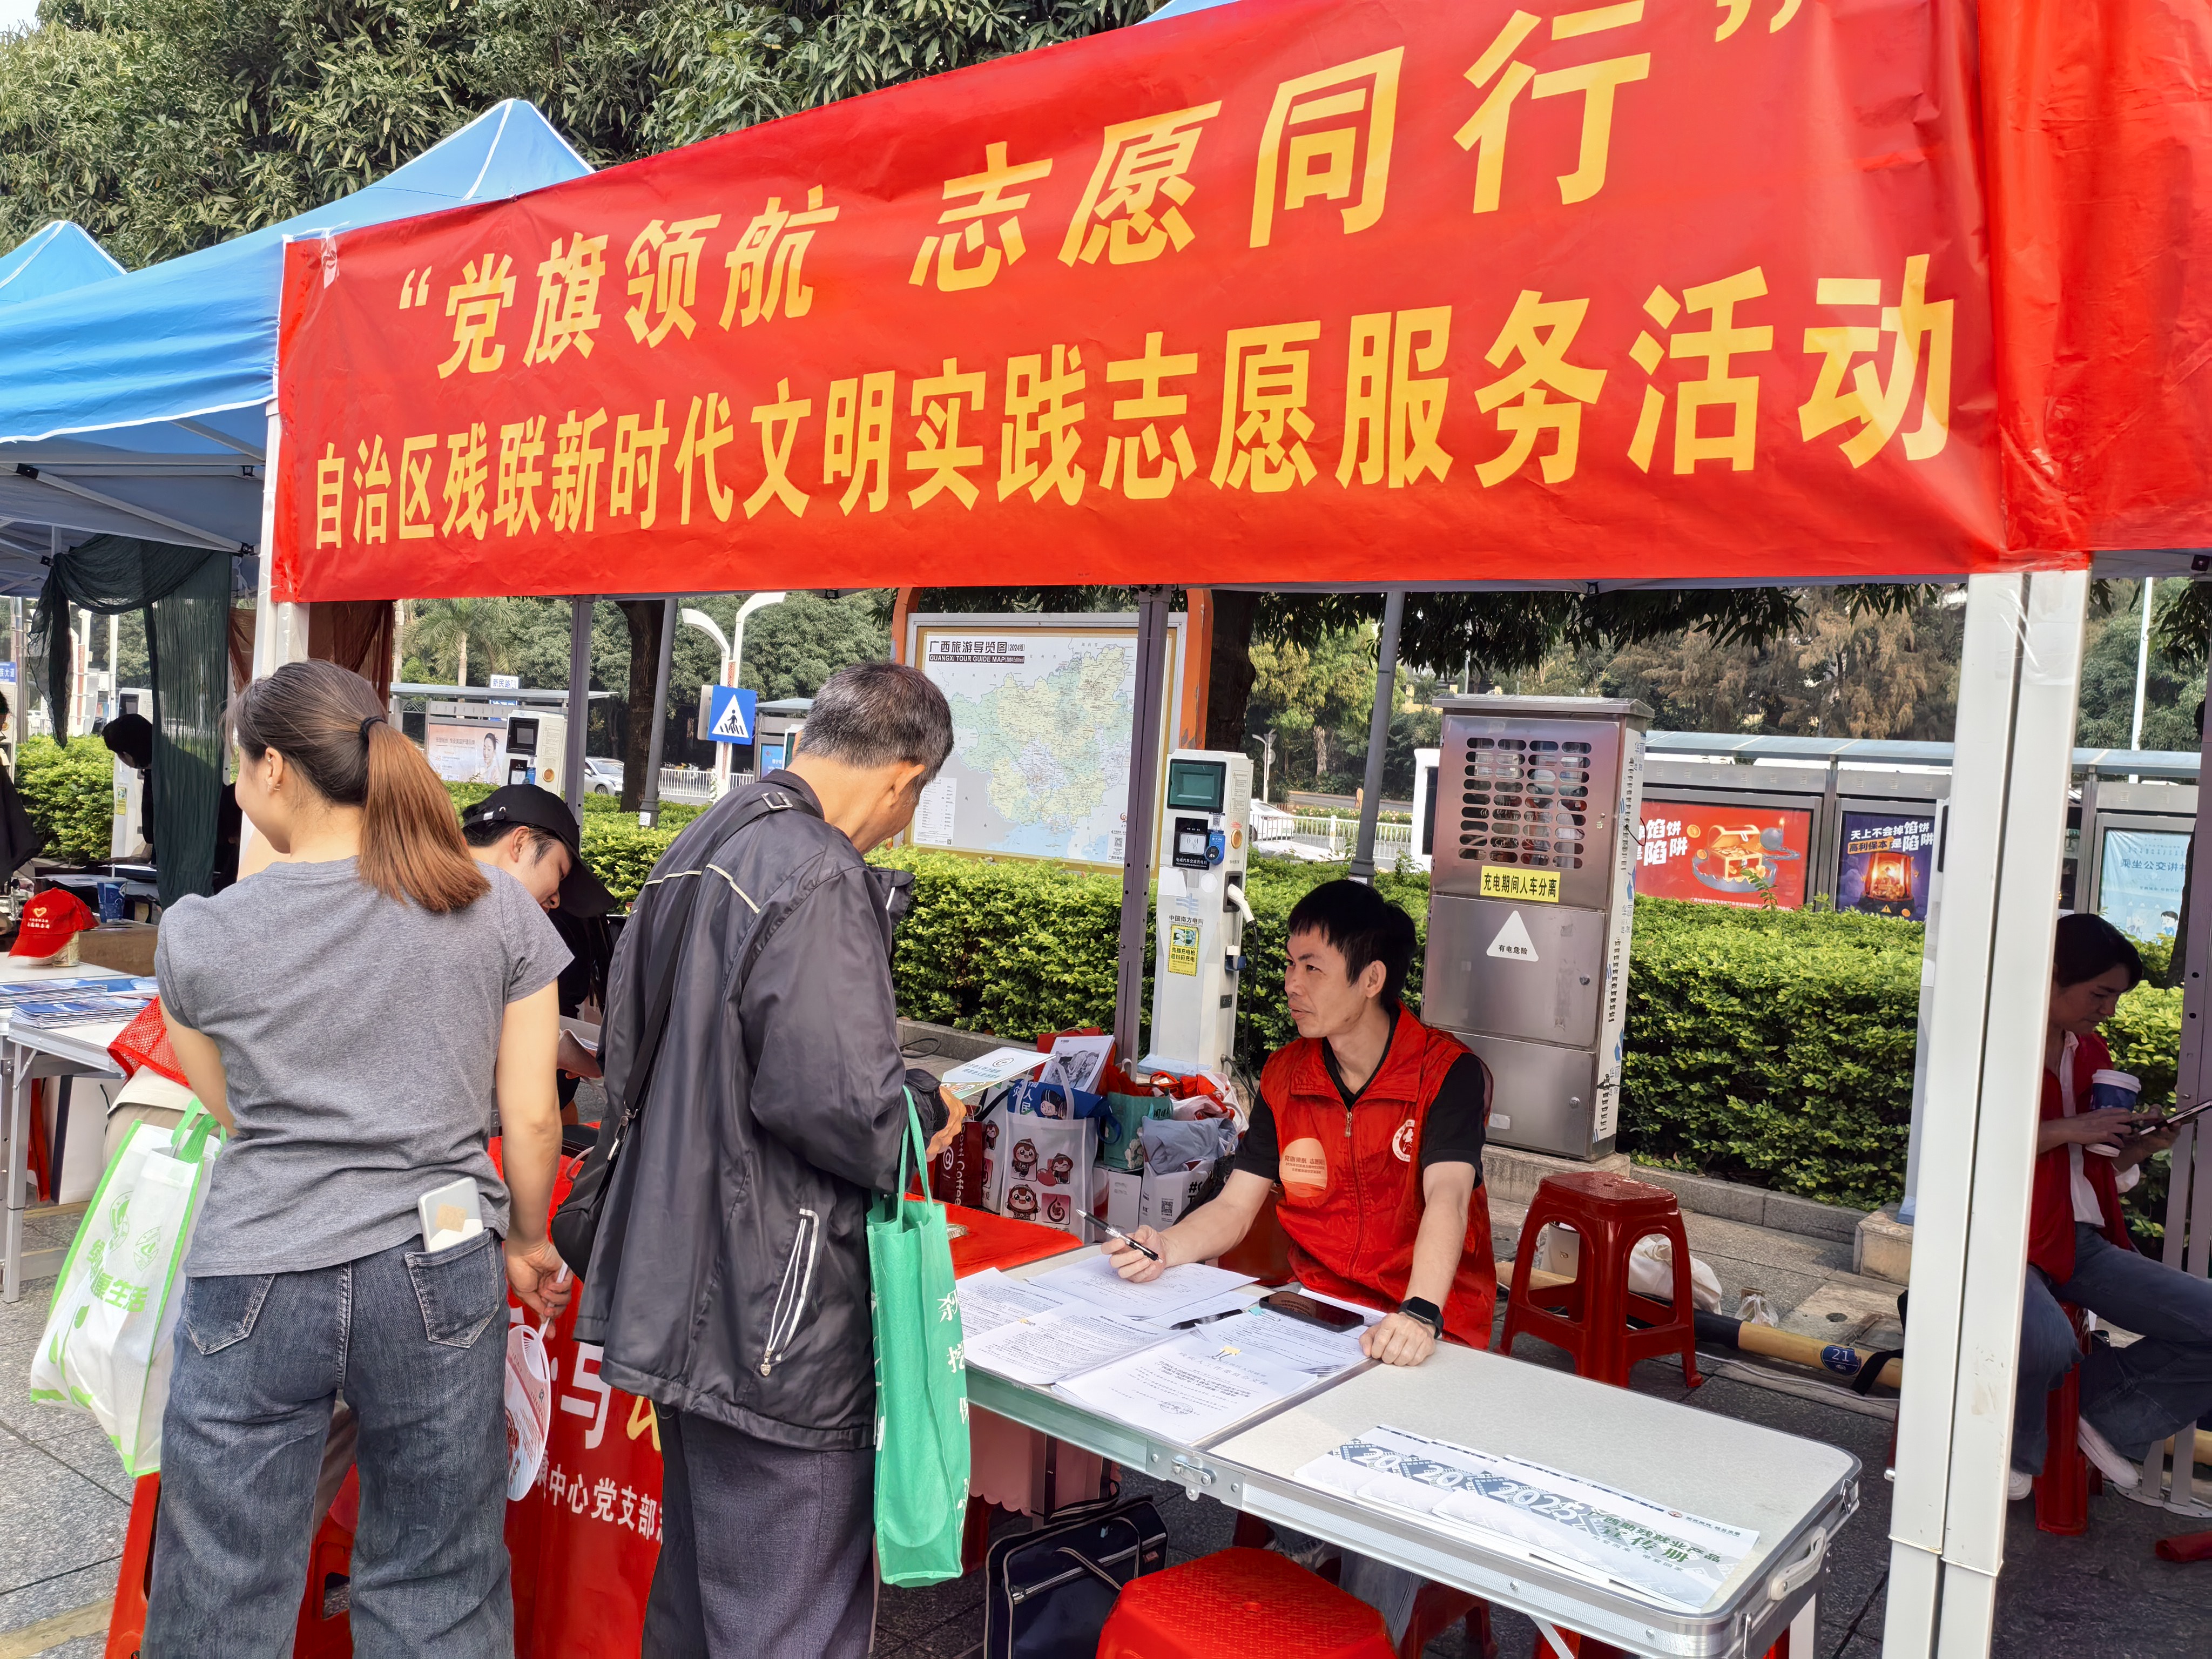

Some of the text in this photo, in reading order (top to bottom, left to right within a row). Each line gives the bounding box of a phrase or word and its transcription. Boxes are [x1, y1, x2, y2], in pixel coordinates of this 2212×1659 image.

[315, 254, 1955, 550] 自治区残联新时代文明实践志愿服务活动
[929, 641, 1007, 653] 广西旅游导览图
[1851, 821, 1930, 841] 天上不会掉馅饼
[1849, 840, 1888, 852] 高利保本
[1483, 872, 1557, 898] 充电期间人车分离
[1169, 914, 1204, 925] 中国南方电网
[1499, 945, 1528, 955] 有电危险
[1831, 1348, 1850, 1362] 21
[535, 1449, 663, 1542] 中心党支部
[1488, 1481, 1583, 1519] 2025
